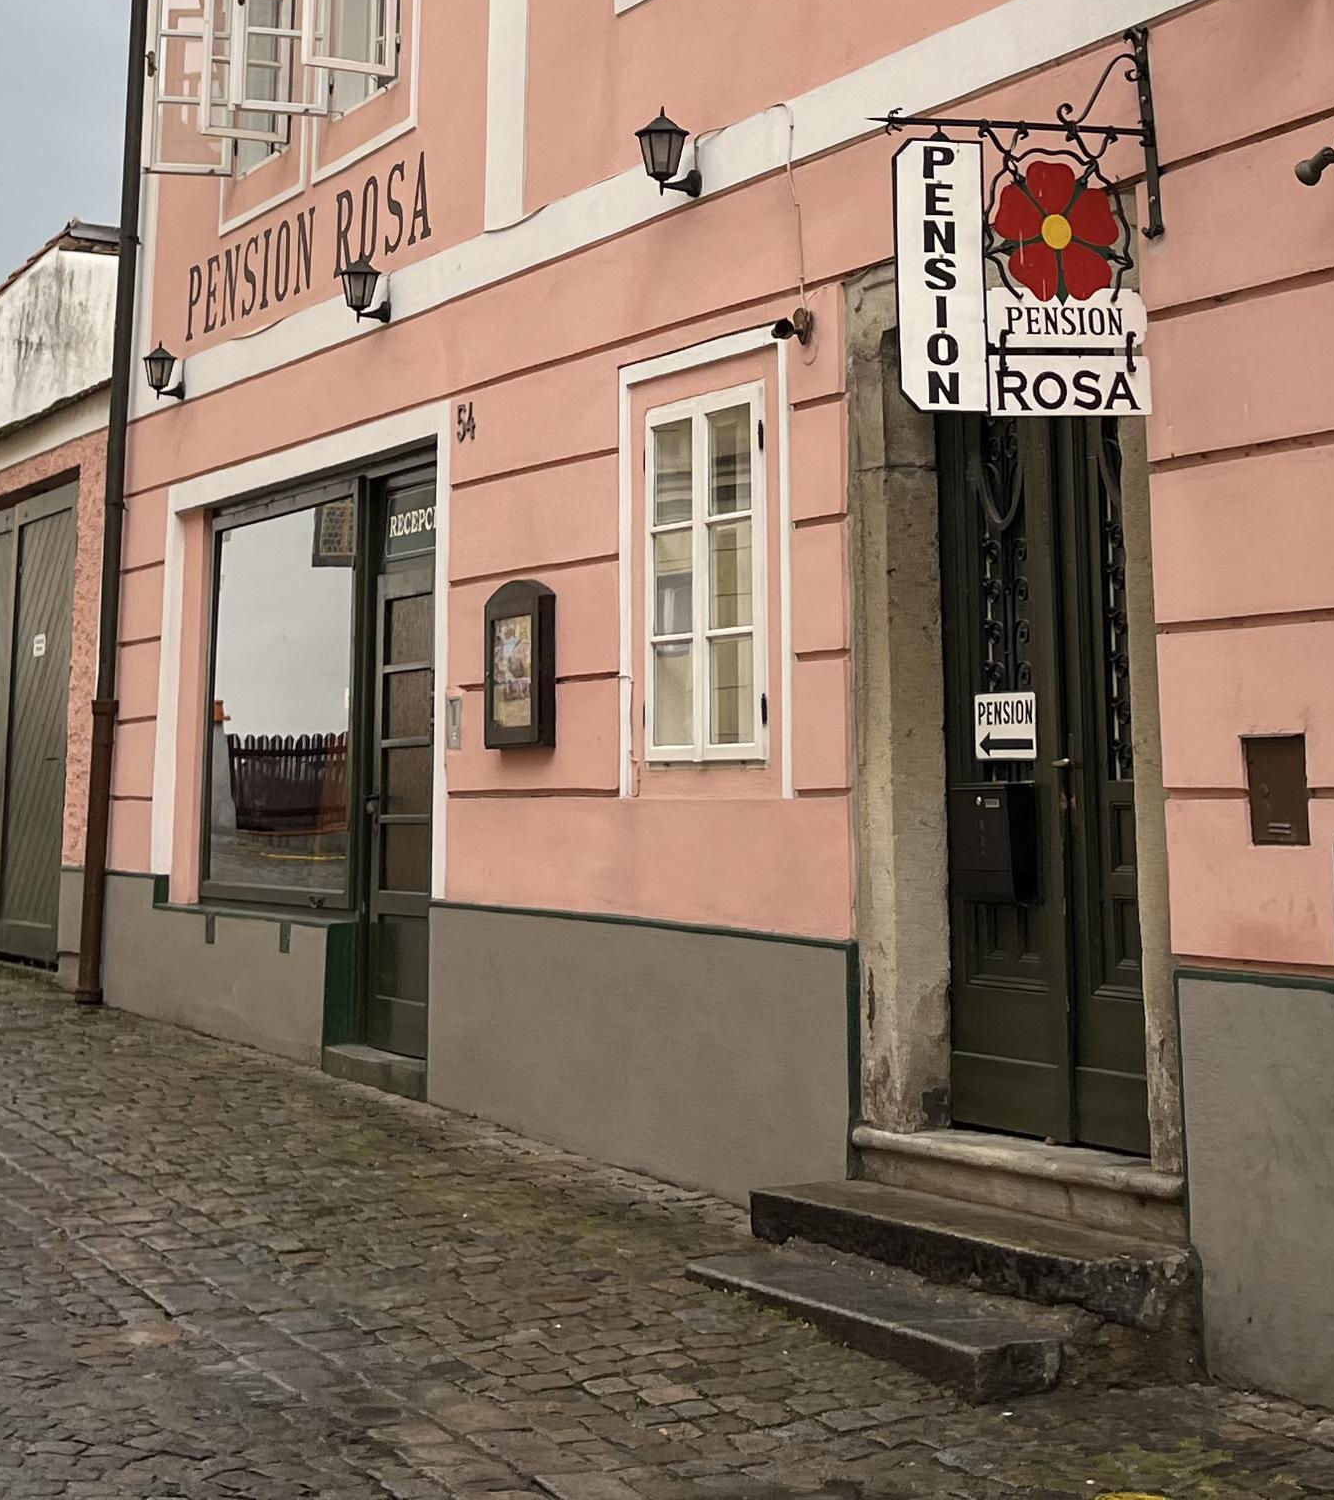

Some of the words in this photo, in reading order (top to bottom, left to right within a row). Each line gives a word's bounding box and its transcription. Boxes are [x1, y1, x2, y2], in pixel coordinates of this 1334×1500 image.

[186, 206, 315, 341] PENSION
[334, 151, 431, 279] ROSA
[923, 145, 960, 405] PENSION
[1005, 306, 1123, 336] PENSION
[997, 370, 1141, 410] ROSA
[457, 402, 475, 442] 54
[978, 699, 1033, 725] PENSION
